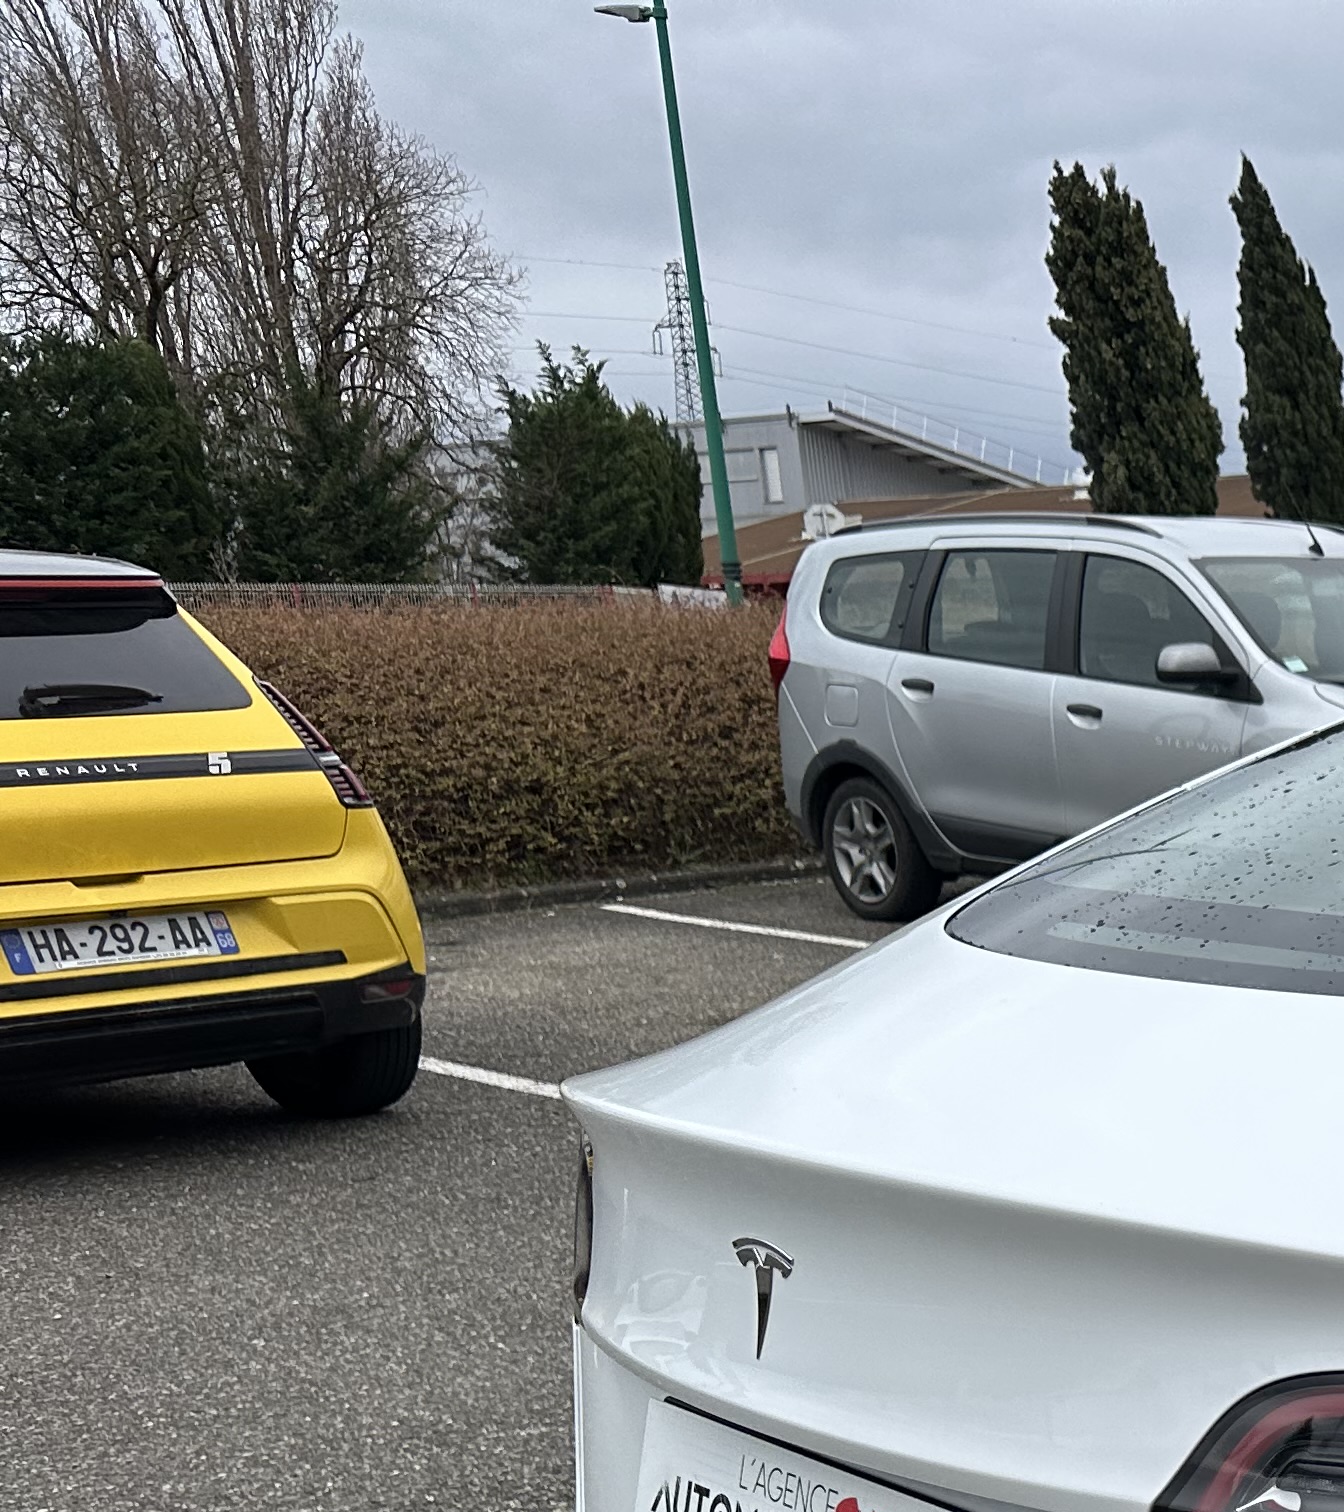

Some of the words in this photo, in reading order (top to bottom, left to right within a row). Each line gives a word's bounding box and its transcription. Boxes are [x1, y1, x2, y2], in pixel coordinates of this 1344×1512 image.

[16, 763, 139, 778] RENAULT
[208, 751, 232, 775] 5
[27, 916, 213, 963] HA-292-AA
[216, 932, 236, 948] 68
[14, 952, 22, 963] F
